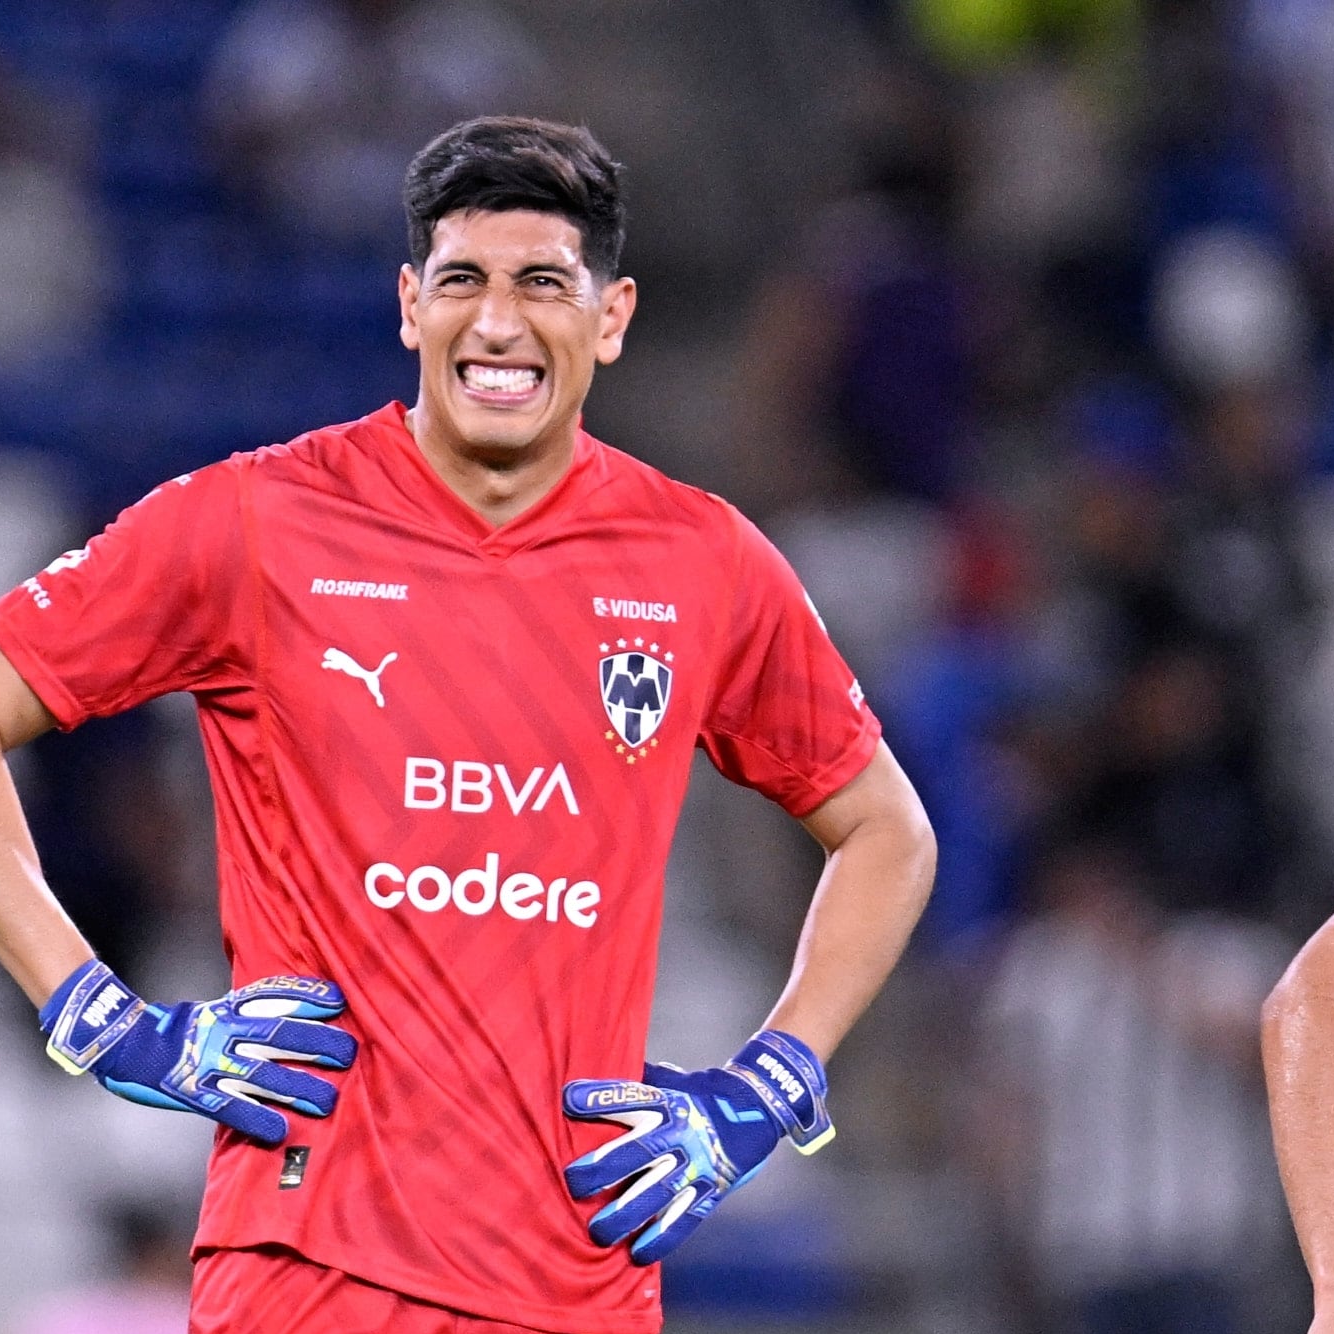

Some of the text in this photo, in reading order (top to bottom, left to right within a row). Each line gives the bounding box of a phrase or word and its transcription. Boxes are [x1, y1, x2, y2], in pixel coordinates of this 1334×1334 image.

[311, 578, 409, 600] ROSHFRANS
[610, 599, 678, 623] VIDUSA
[404, 756, 581, 817] BBVA
[364, 852, 601, 929] codere
[755, 1052, 806, 1103] Esteban
